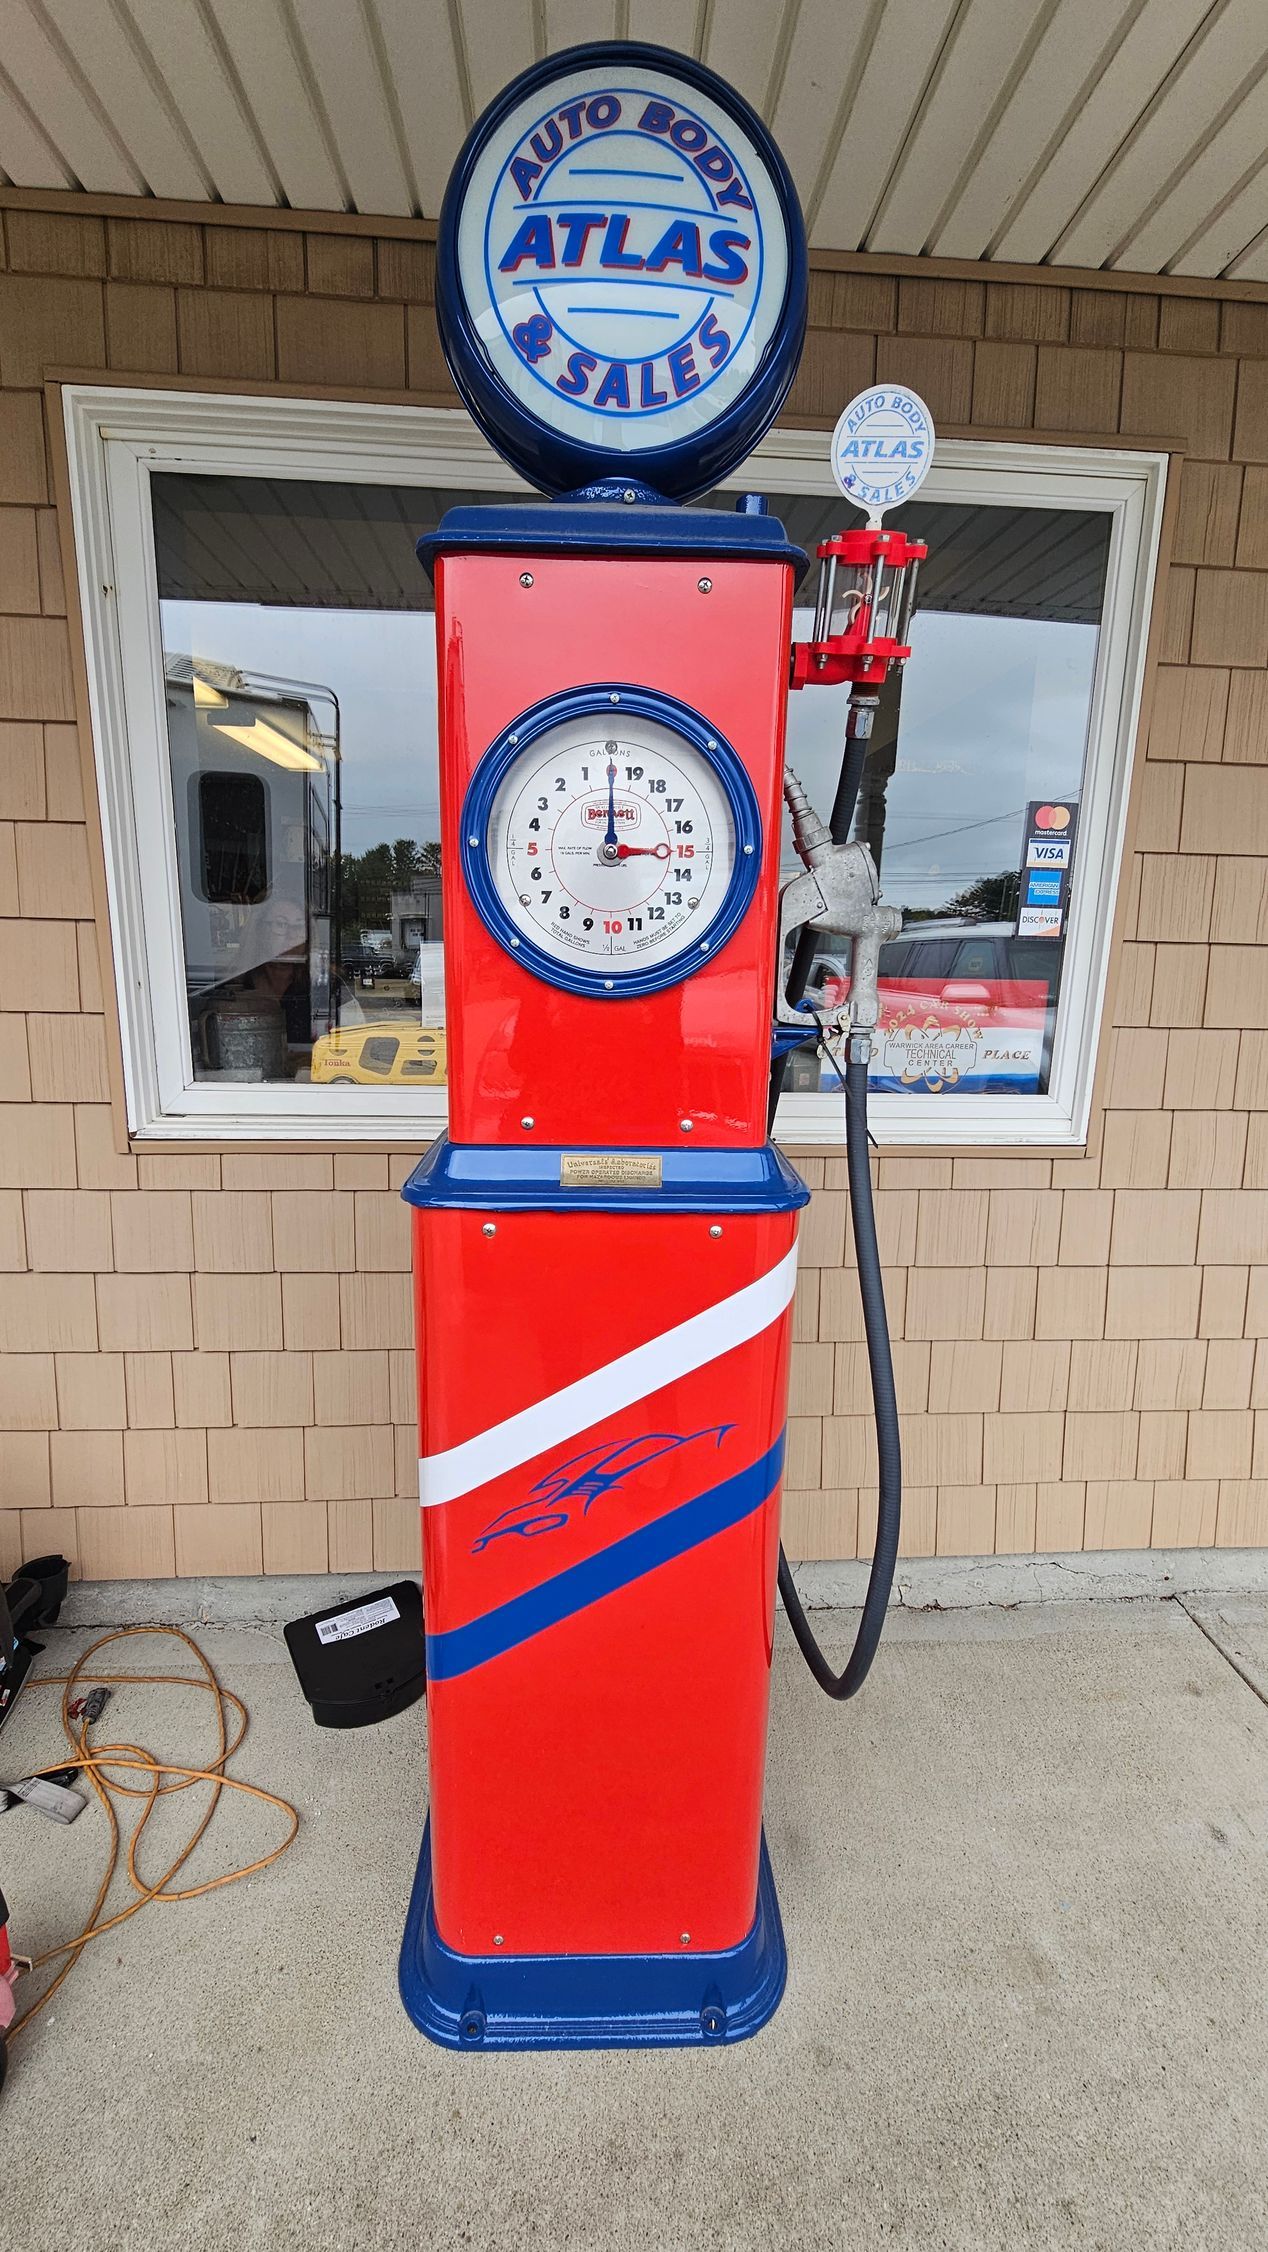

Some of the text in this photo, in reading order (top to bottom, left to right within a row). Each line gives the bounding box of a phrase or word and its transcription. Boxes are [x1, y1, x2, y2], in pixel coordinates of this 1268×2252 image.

[509, 95, 753, 211] AUTO BODY
[498, 211, 751, 286] ATLAS
[512, 312, 731, 409] & SALES
[847, 394, 927, 434] AUTO BODY
[840, 440, 925, 459] ATLAS
[858, 471, 916, 503] SALES
[589, 749, 631, 758] GALNS
[581, 766, 589, 781] 1
[625, 766, 644, 781] 19
[554, 777, 566, 792] 2
[648, 779, 667, 794] 18
[537, 796, 549, 811] 3
[665, 798, 685, 813] 17
[528, 817, 541, 832] 4
[674, 820, 694, 834] 16
[1034, 829, 1068, 837] mastercard
[527, 842, 539, 857] 5
[676, 844, 695, 859] 15
[1034, 847, 1064, 860] VISA
[530, 866, 542, 881] 6
[674, 868, 693, 882] 14
[541, 890, 553, 904] 7
[664, 891, 683, 906] 13
[559, 905, 570, 920] 8
[647, 906, 665, 920] 12
[1022, 915, 1059, 925] DISCOVER
[582, 917, 594, 932] 9
[603, 920, 623, 935] 10
[627, 917, 643, 931] 11
[633, 936, 650, 945] HANDS
[649, 929, 662, 939] MUST
[667, 917, 676, 926] SET
[550, 927, 564, 939] TOTAL
[560, 928, 573, 938] HAND
[636, 915, 686, 949] ZERO BEFORE STARTING
[954, 1006, 984, 1039] SHOW
[905, 1048, 957, 1060] TECHNICAL
[982, 1049, 1032, 1060] PLACE
[323, 1058, 351, 1067] Tonka
[908, 1059, 953, 1067] CENTER
[356, 1617, 387, 1633] Rodent
